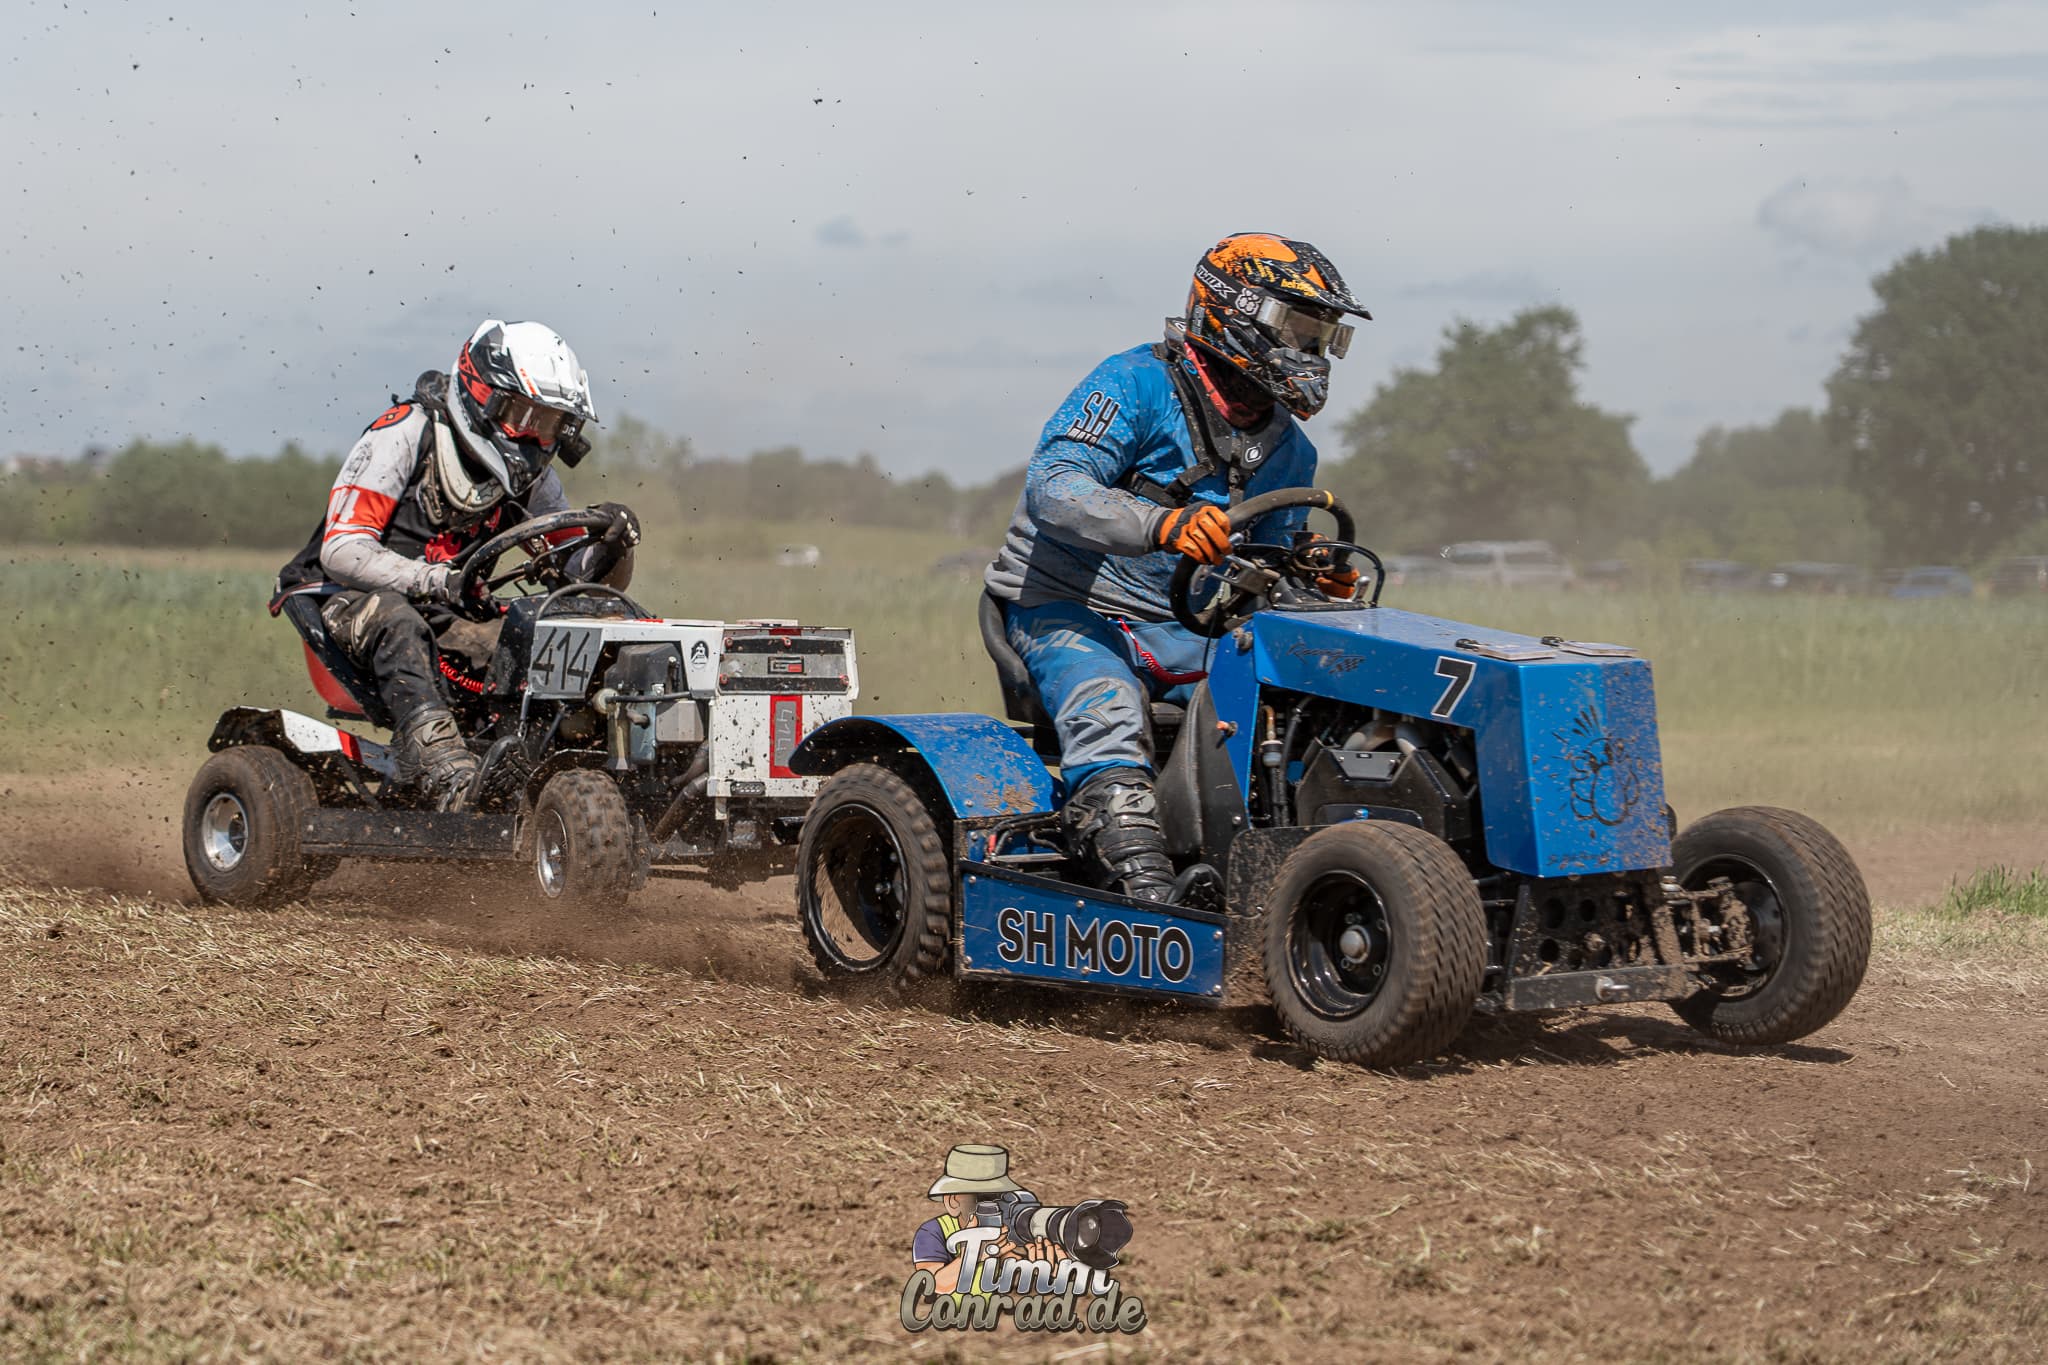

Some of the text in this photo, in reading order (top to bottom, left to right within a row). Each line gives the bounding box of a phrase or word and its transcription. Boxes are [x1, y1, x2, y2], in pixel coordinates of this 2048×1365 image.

[1071, 390, 1121, 436] SH
[532, 627, 590, 691] 414
[1431, 656, 1477, 717] 7
[997, 907, 1194, 984] SH MOTO
